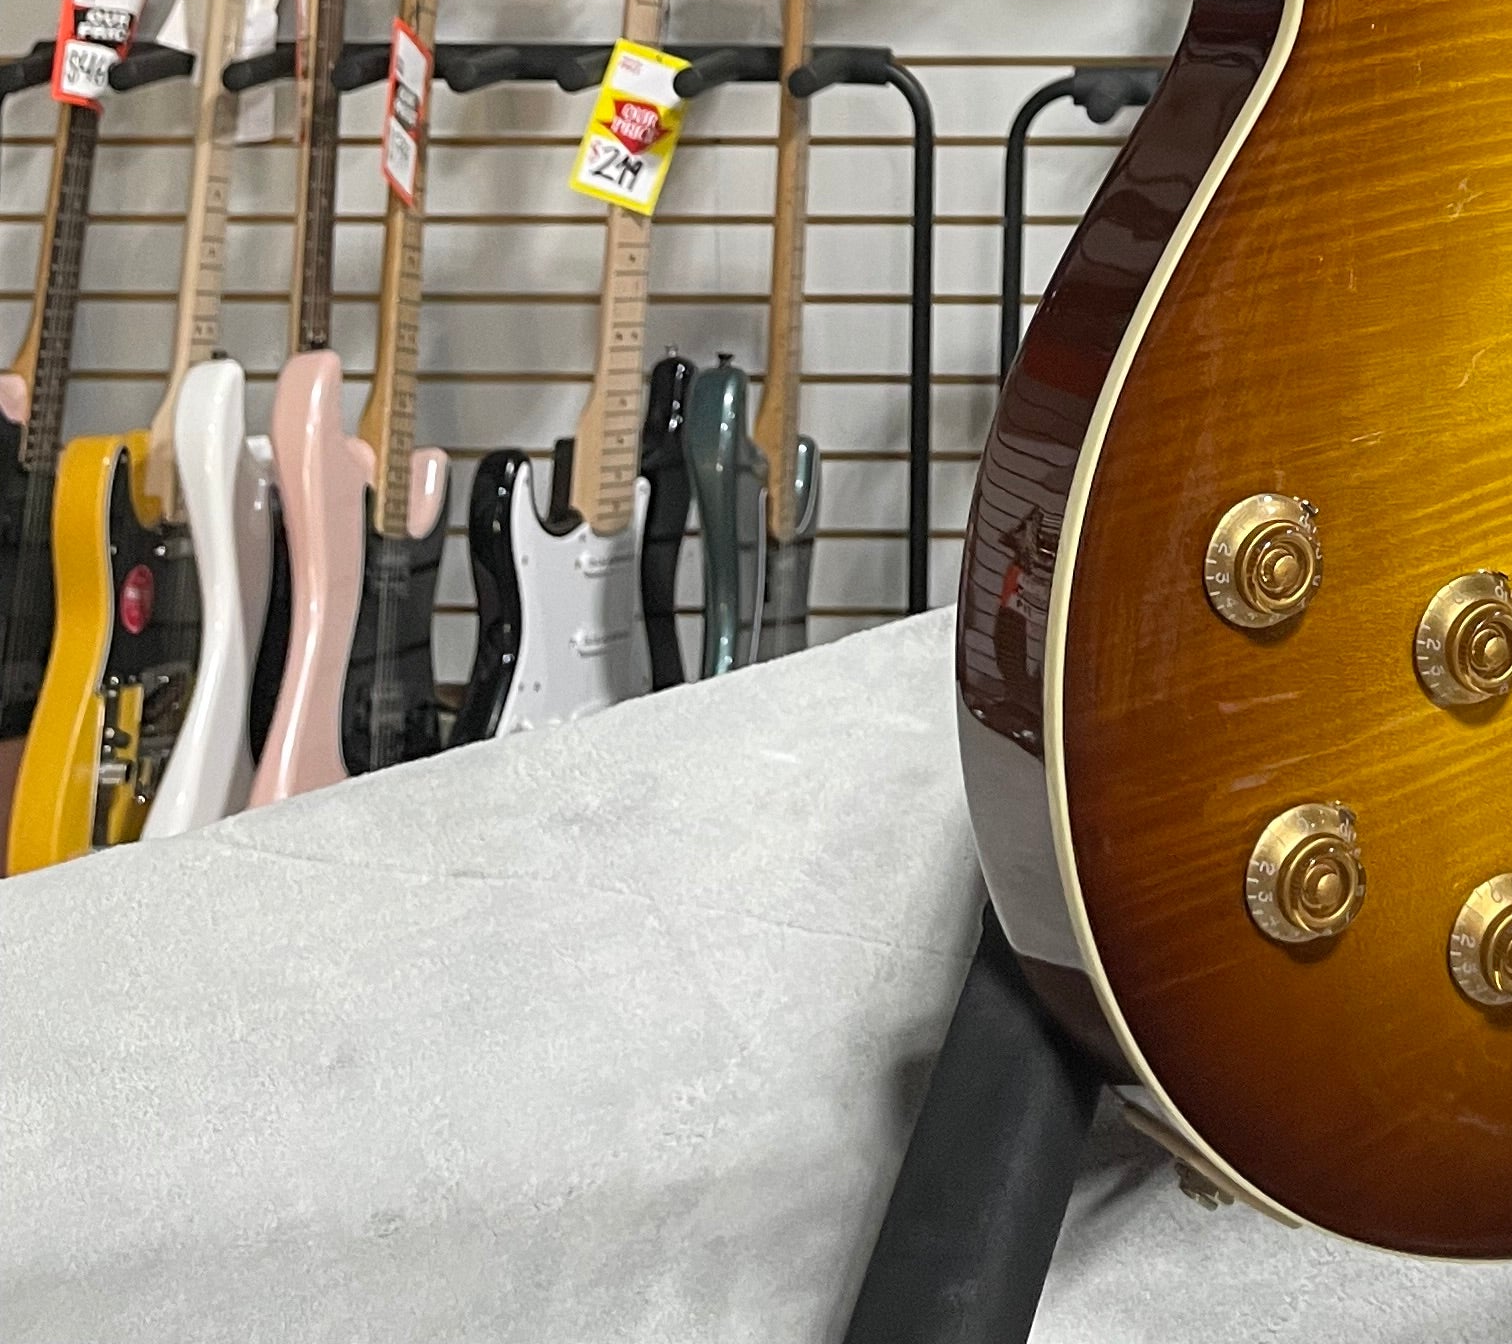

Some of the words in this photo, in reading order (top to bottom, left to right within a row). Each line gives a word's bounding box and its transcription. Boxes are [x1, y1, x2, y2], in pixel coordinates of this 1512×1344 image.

[1426, 638, 1441, 651] 2
[1259, 861, 1275, 876] 2
[1460, 933, 1476, 948] 2
